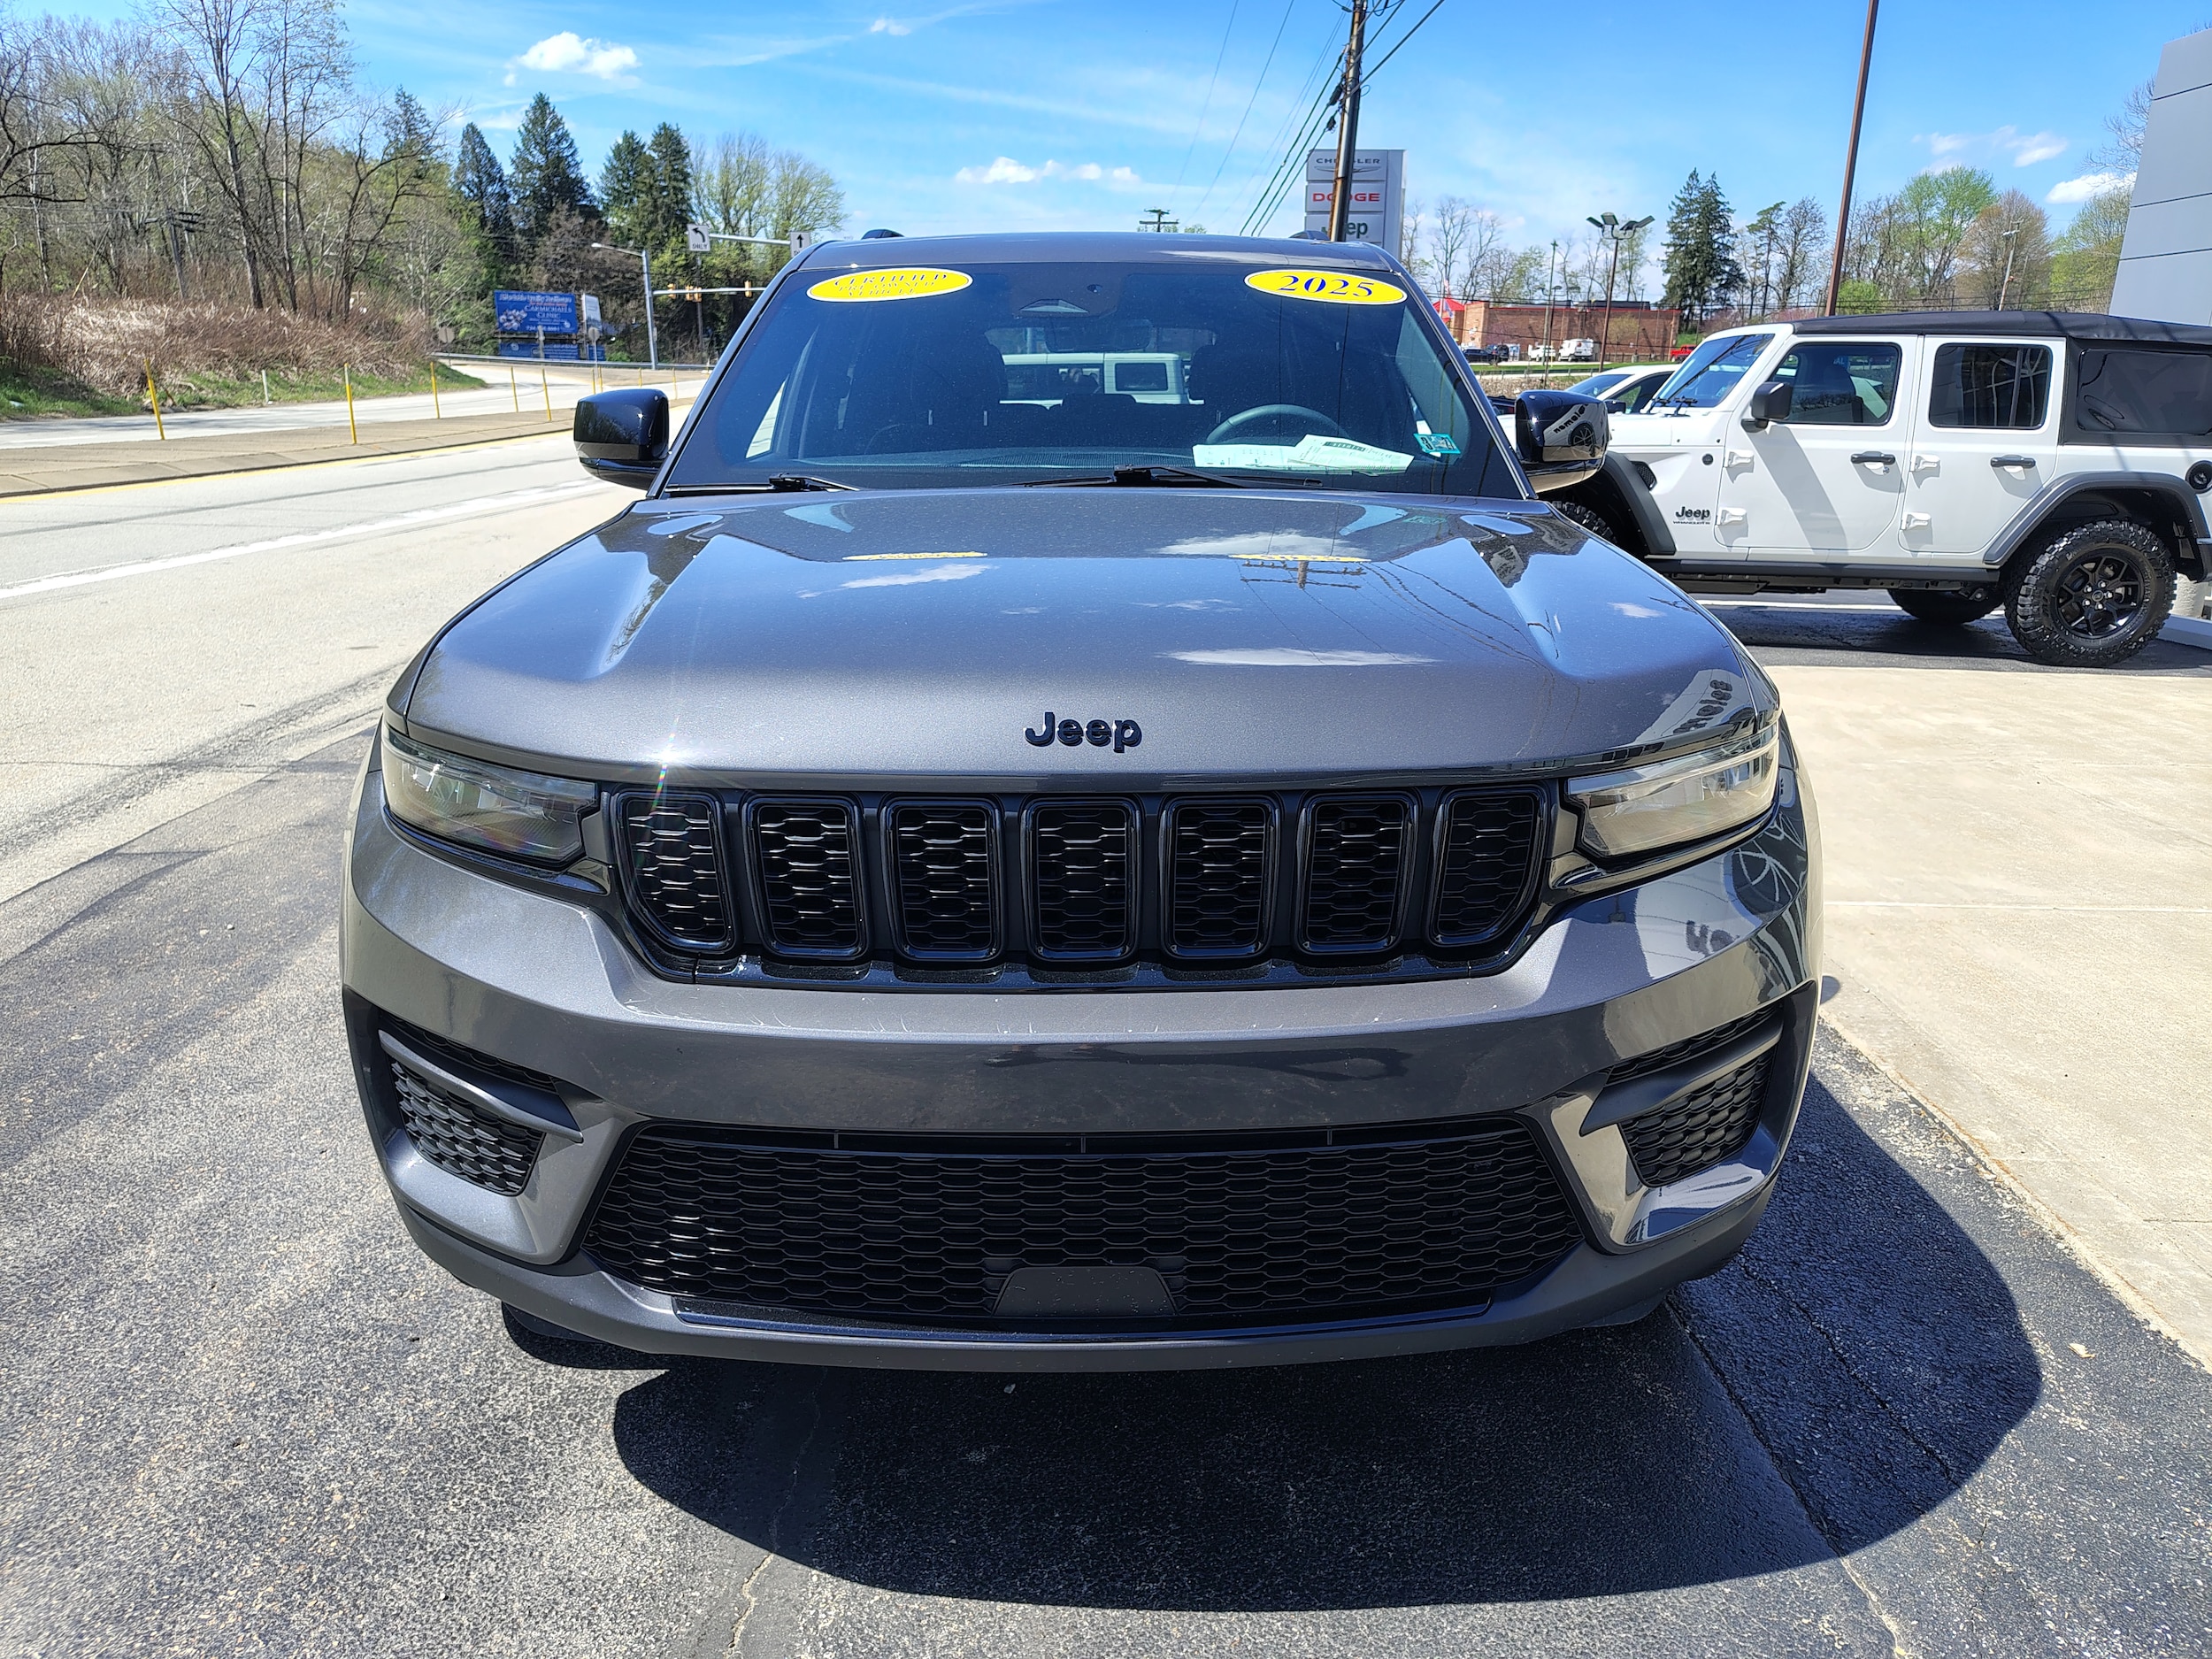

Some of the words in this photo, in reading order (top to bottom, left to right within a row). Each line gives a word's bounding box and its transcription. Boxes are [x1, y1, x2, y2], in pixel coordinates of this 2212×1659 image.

[1313, 192, 1380, 203] DGE
[1277, 274, 1375, 297] 2025
[1675, 506, 1710, 520] Jeep
[1023, 711, 1143, 754] Jeep
